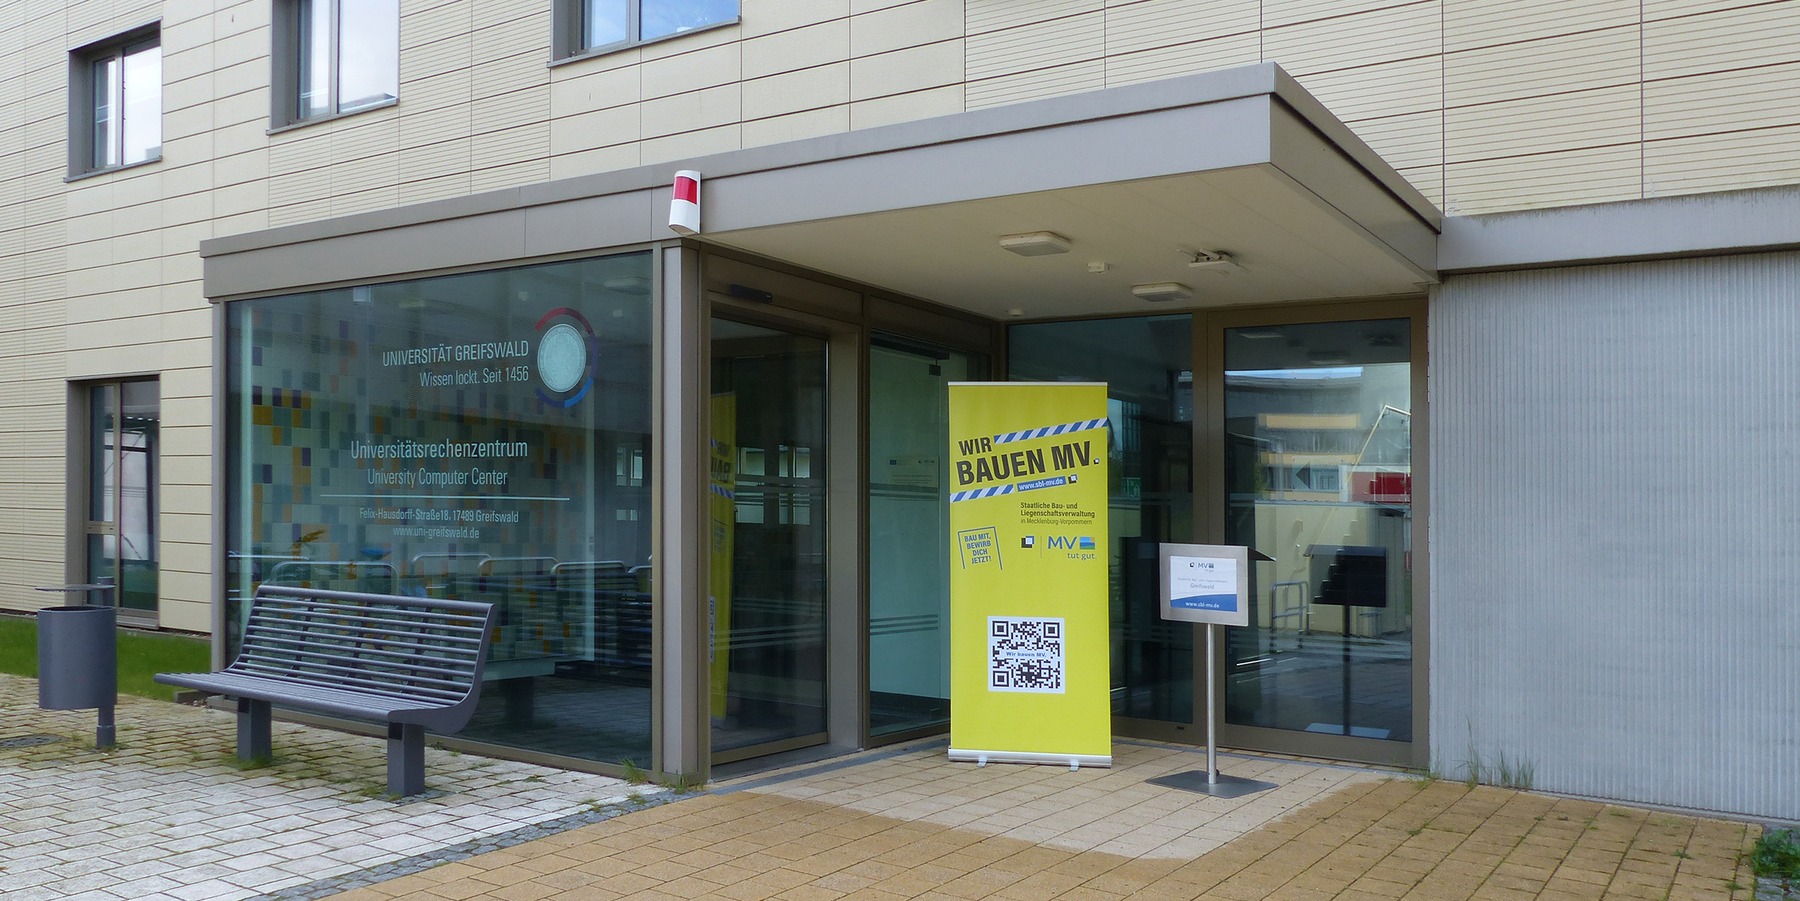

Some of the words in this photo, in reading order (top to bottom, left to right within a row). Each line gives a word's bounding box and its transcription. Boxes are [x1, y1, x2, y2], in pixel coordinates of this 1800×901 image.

[382, 343, 453, 367] UNIVERSITÄT
[455, 340, 529, 362] GREIFSWALD
[420, 371, 453, 387] Wissen
[456, 369, 481, 385] lockt.
[483, 367, 502, 383] Seit
[505, 365, 529, 382] 1456
[350, 438, 528, 459] Universitätsrechenzentrum
[958, 437, 992, 456] WIR
[956, 448, 1046, 486] BAUEN
[1051, 440, 1100, 471] MV.
[367, 468, 416, 488] University
[418, 467, 469, 488] Computer
[471, 467, 508, 485] Center
[452, 509, 474, 522] 17489
[475, 510, 519, 523] Greifswald
[1020, 510, 1095, 518] Liegenschaftsverwaltung
[393, 526, 480, 540] www.uni-greifswald.de
[966, 541, 991, 549] BEWIRB
[1047, 536, 1077, 549] MV
[971, 556, 991, 564] JETZT!
